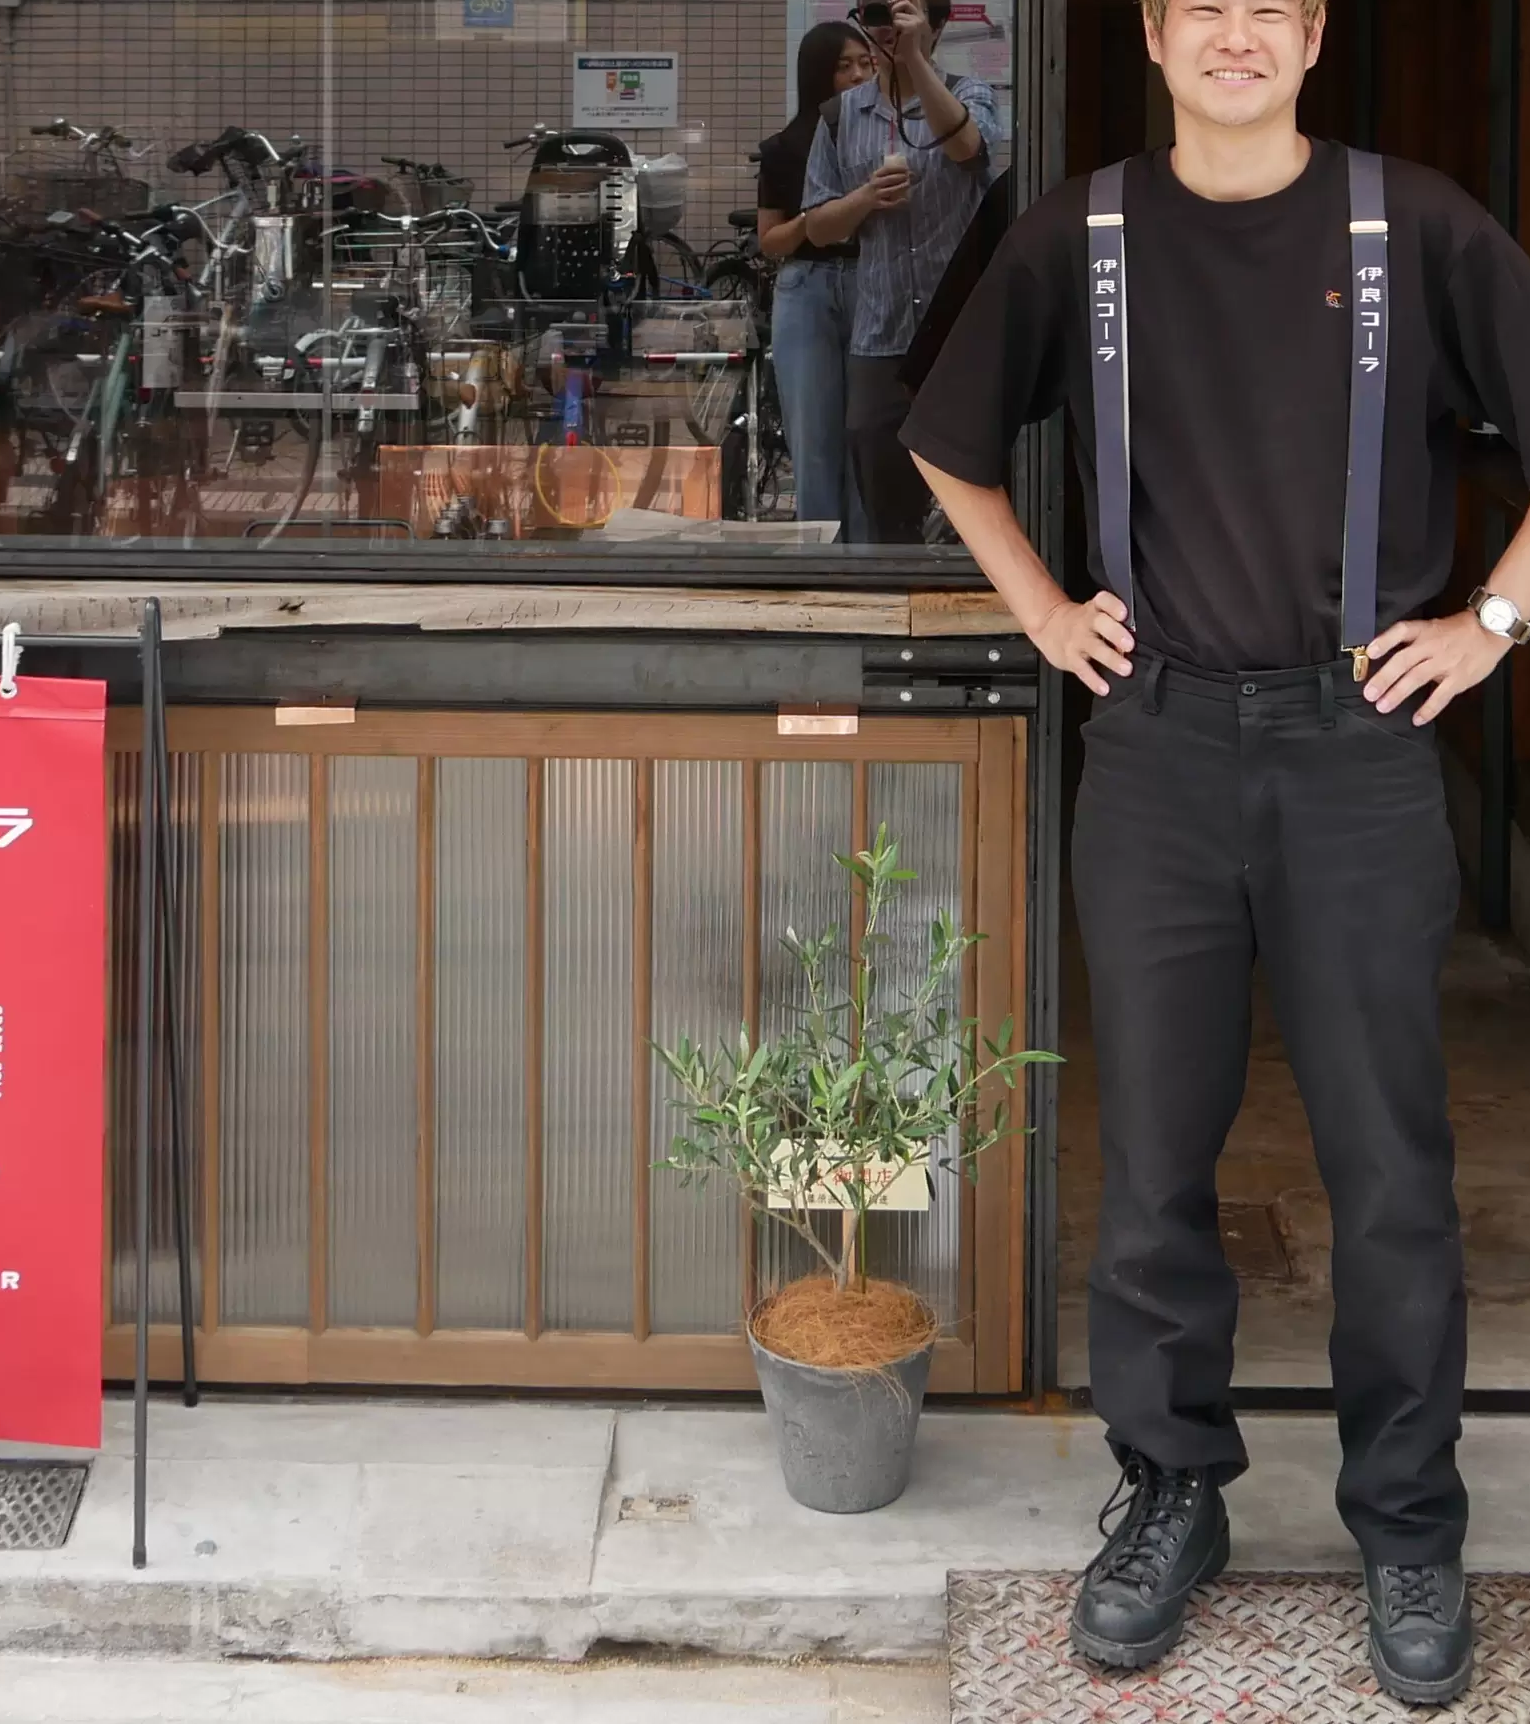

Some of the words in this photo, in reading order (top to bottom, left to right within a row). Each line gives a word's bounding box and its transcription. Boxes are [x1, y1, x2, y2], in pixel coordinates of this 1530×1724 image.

[1092, 258, 1118, 363] 伊良コーラ
[1356, 266, 1384, 374] 伊良コーラ
